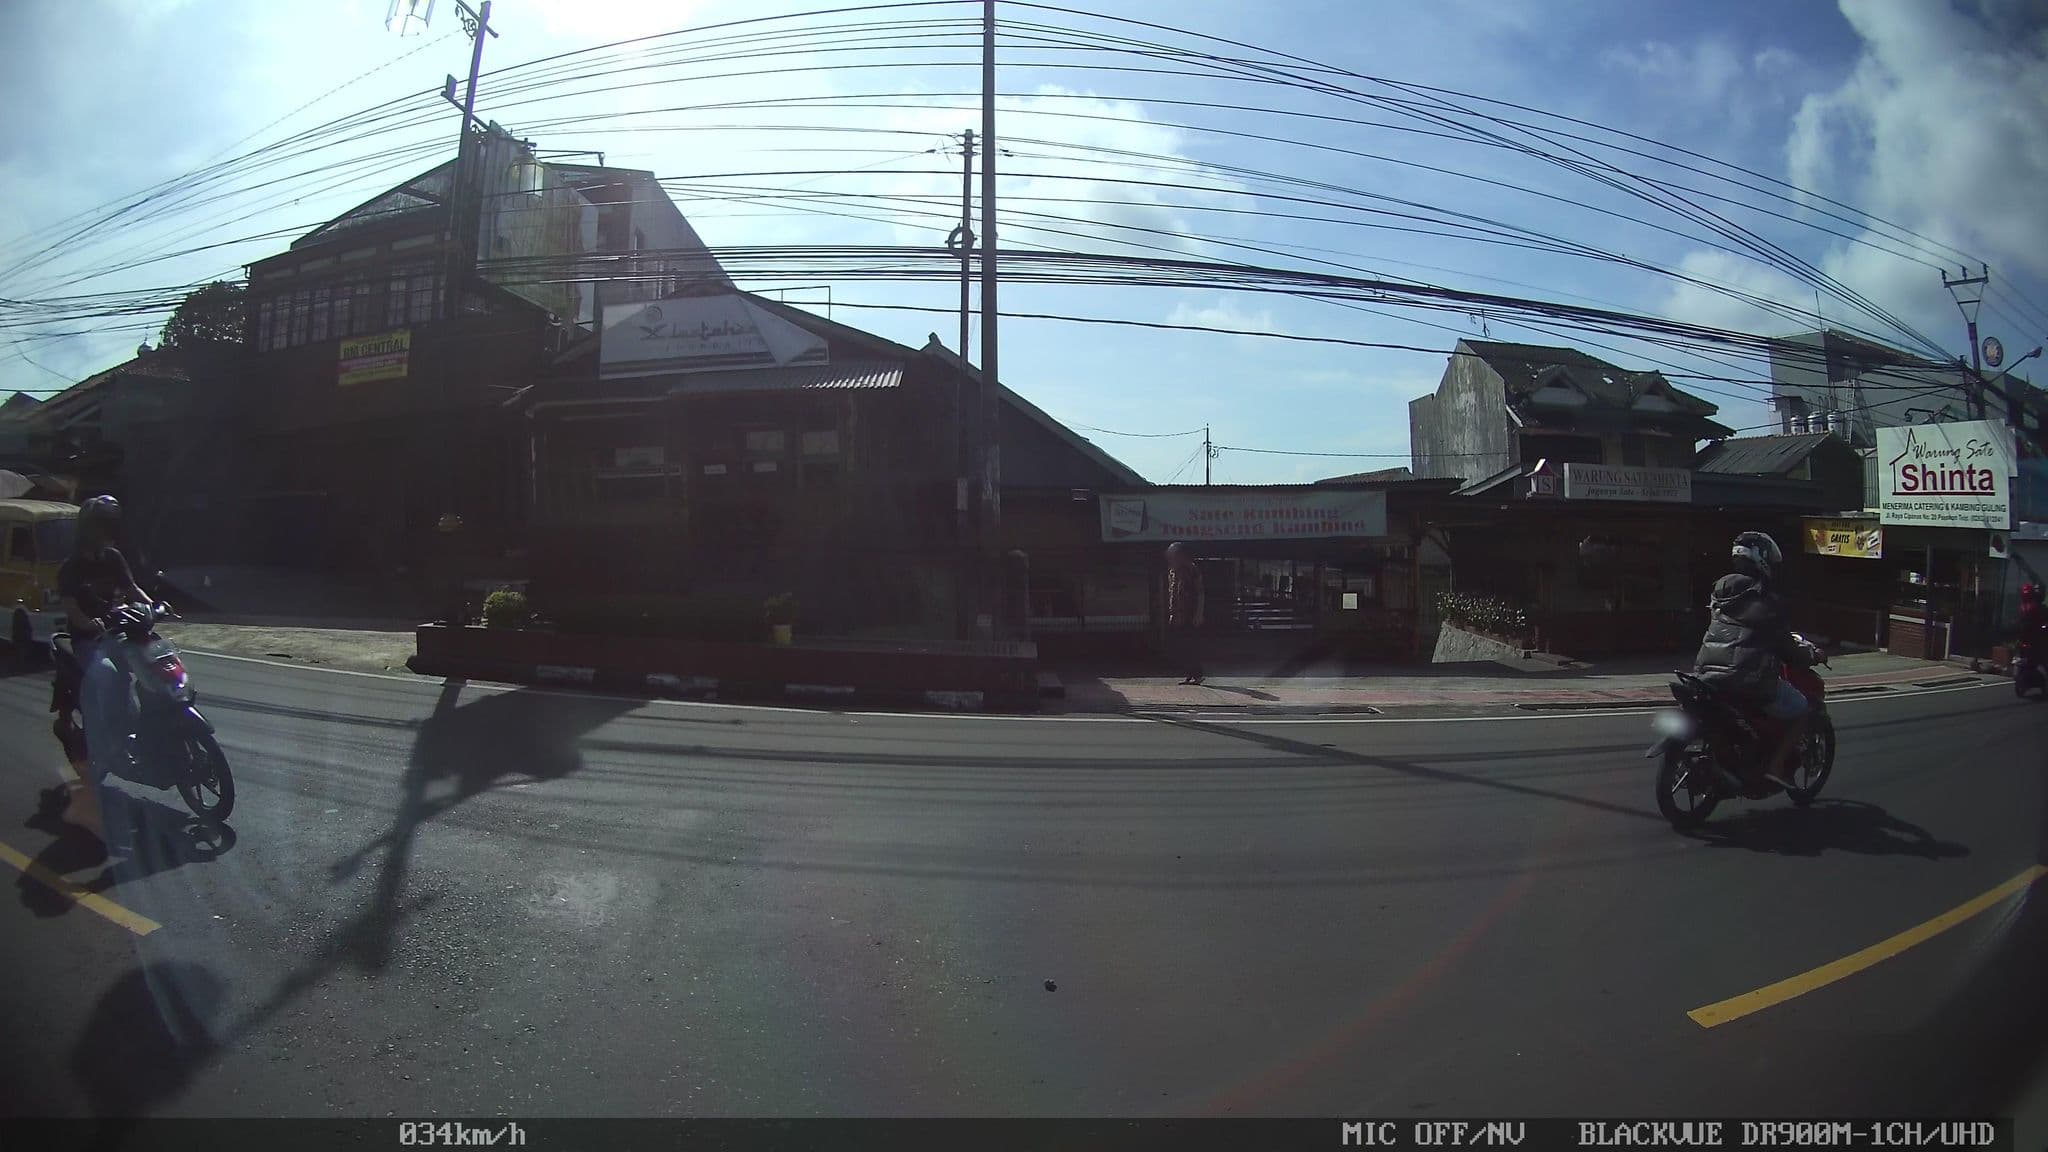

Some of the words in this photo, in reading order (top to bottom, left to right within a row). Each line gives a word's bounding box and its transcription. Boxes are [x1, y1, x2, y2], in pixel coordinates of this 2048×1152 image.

[1913, 441, 1960, 463] Warung
[1966, 439, 1993, 459] Sate
[1572, 470, 1622, 484] WARUNG
[1624, 471, 1649, 486] SATE
[1902, 463, 1994, 491] Shinta
[1882, 502, 1913, 510] MENERIMA
[1914, 502, 1944, 511] CATERING
[1945, 503, 1950, 511] &
[1951, 503, 1980, 511] KAMBING
[1981, 503, 2006, 512] GULING
[1891, 512, 1903, 520] Raya
[1830, 534, 1850, 544] GRATIS
